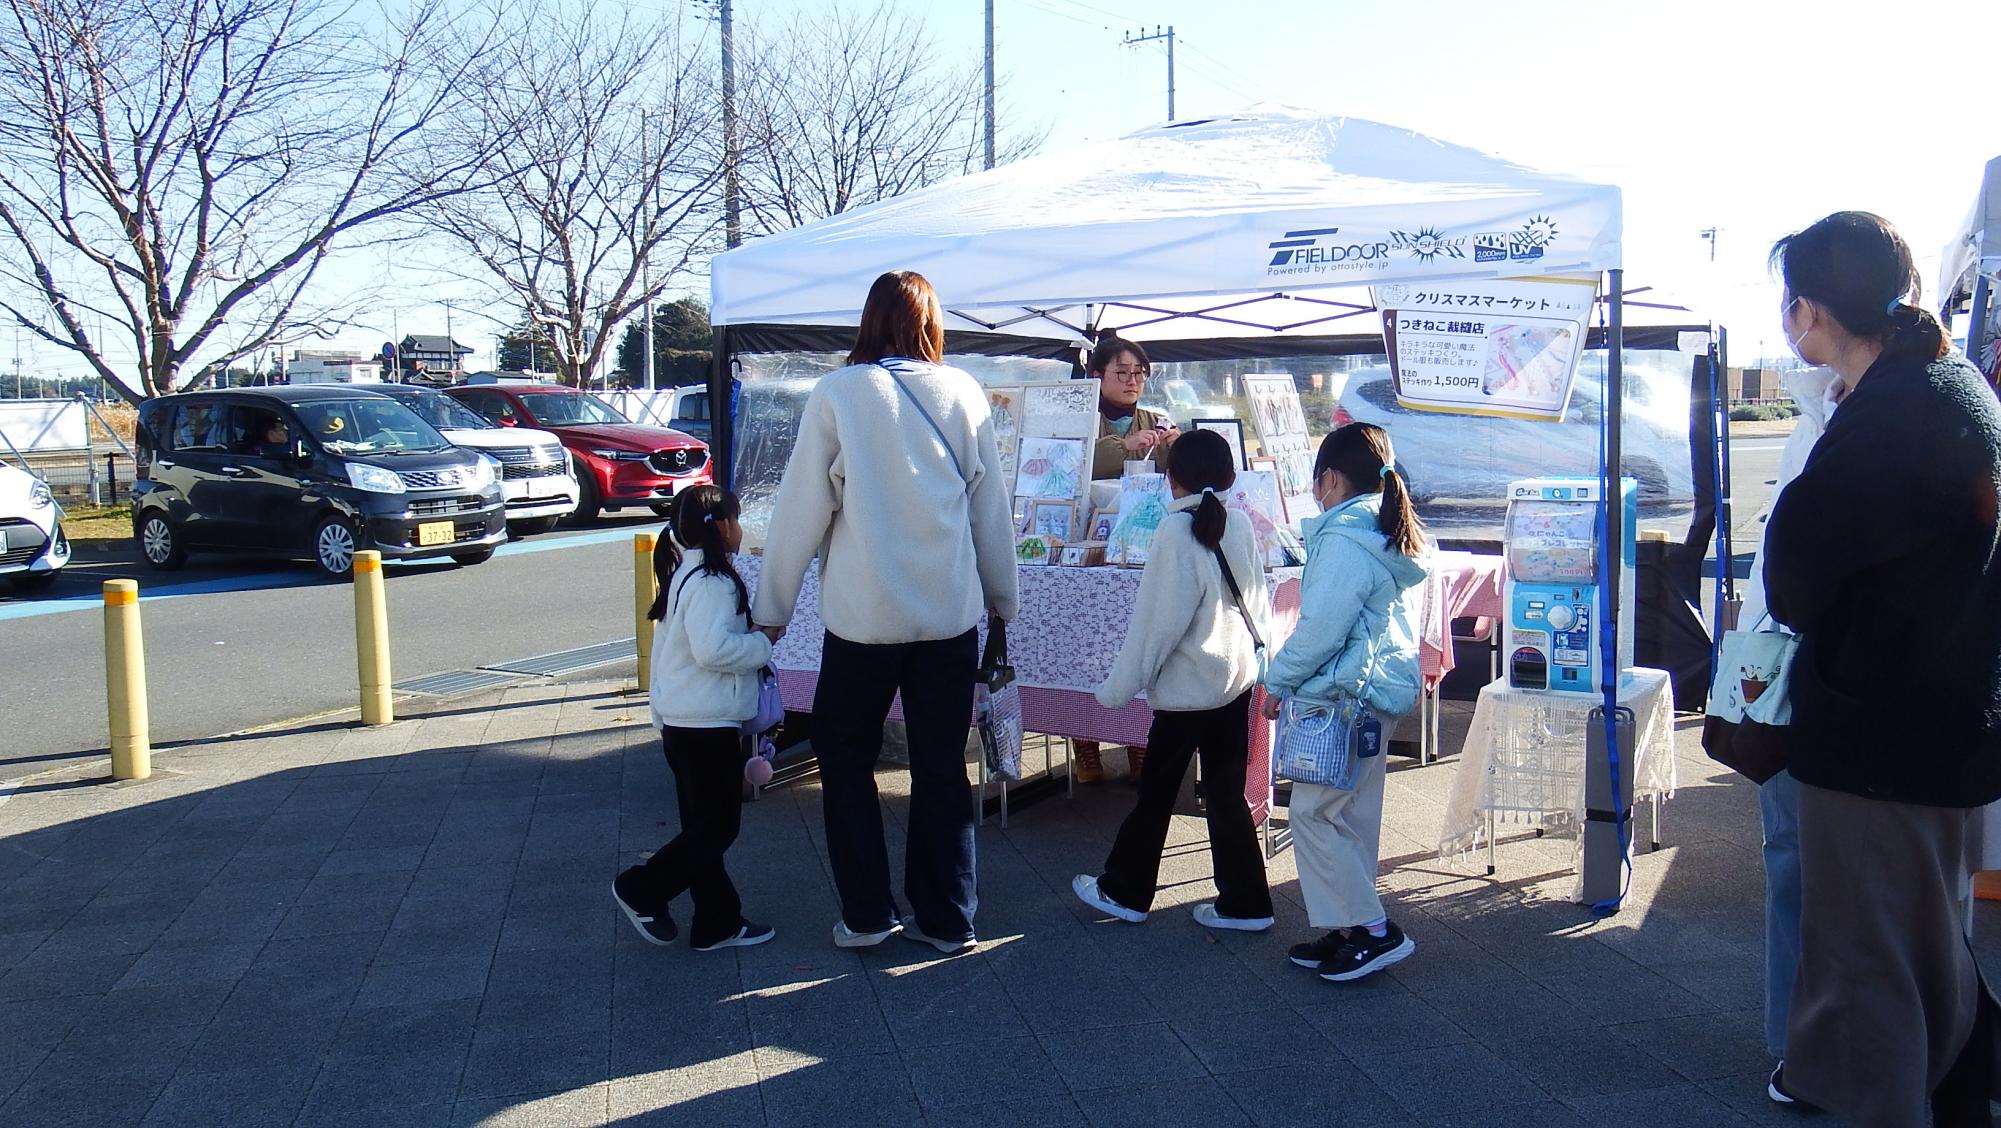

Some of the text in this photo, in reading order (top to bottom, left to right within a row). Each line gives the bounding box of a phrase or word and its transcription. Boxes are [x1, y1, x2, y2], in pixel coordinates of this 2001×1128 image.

[1295, 242, 1389, 264] FIELDOOR
[1511, 243, 1533, 255] UV
[1267, 261, 1389, 276] Powered by ottostyle.jp
[1415, 291, 1550, 311] クリスマスマーケット
[1386, 317, 1393, 329] 4
[1400, 318, 1486, 335] つきねこ裁縫店
[1434, 375, 1479, 388] 1,500円
